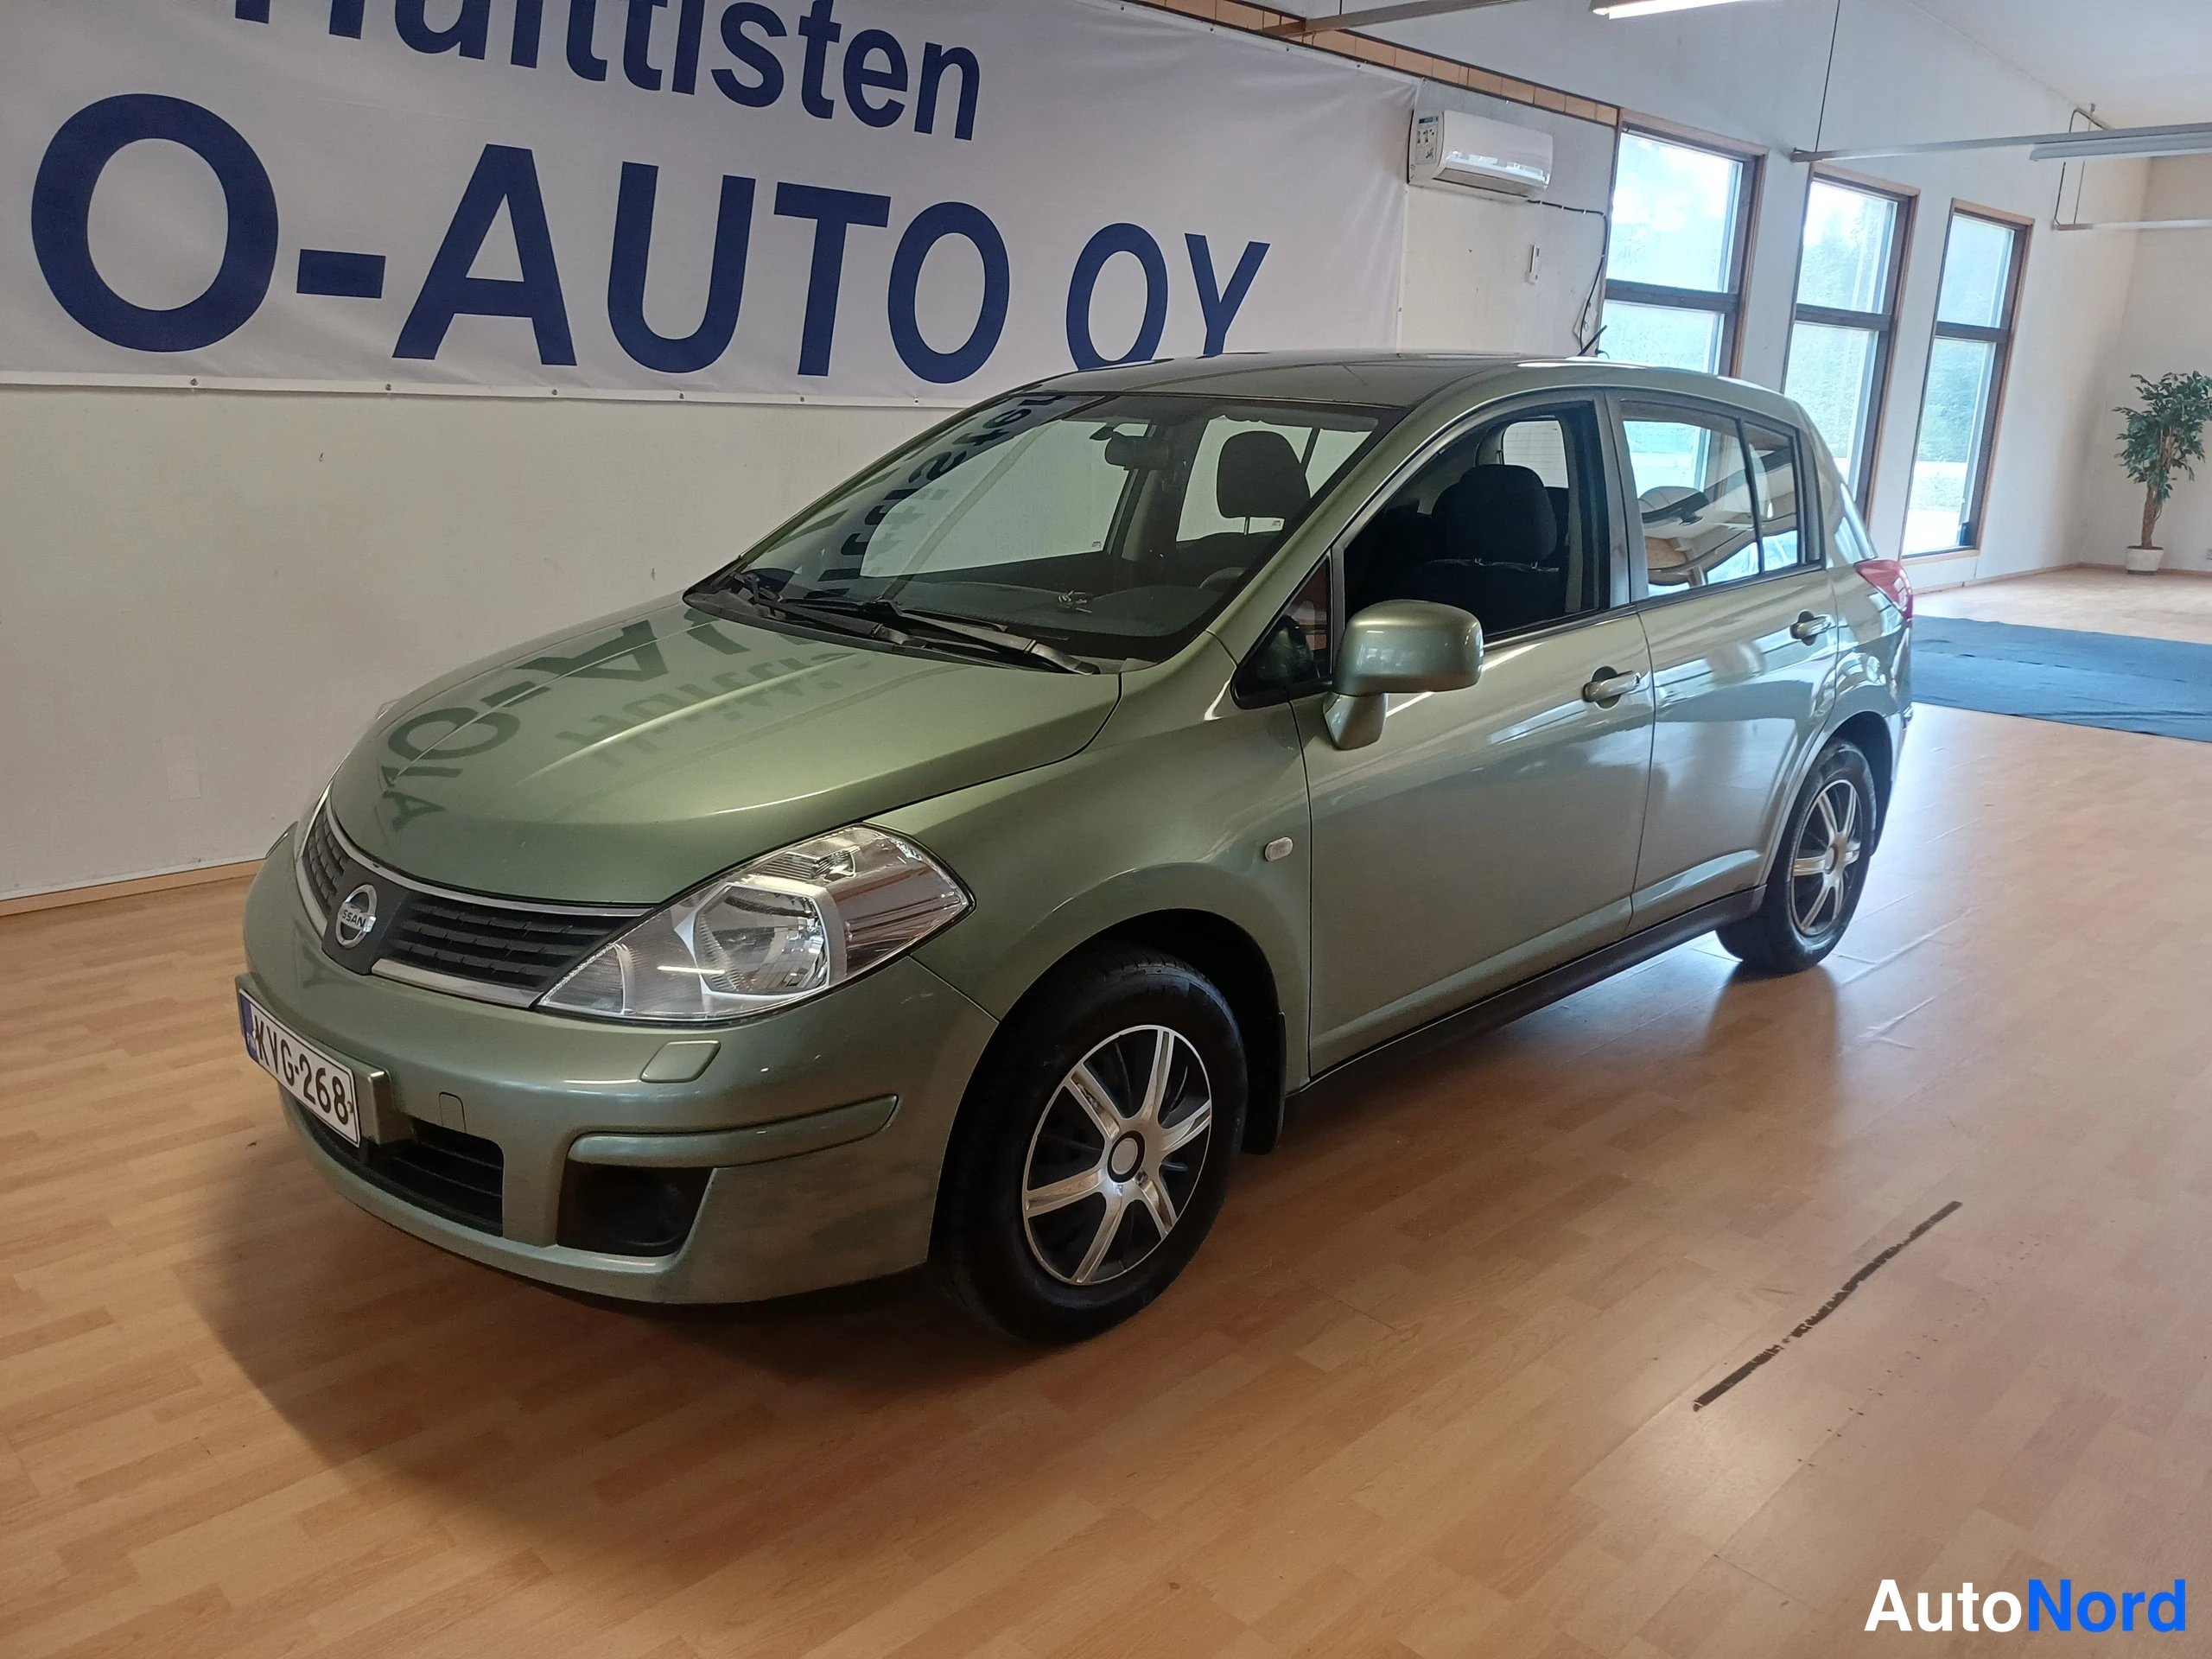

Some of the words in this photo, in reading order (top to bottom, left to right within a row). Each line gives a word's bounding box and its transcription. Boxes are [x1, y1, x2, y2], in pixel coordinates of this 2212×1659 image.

[235, 0, 980, 141] uittisten
[31, 93, 1010, 384] O-AUTO
[1065, 222, 1271, 371] OY
